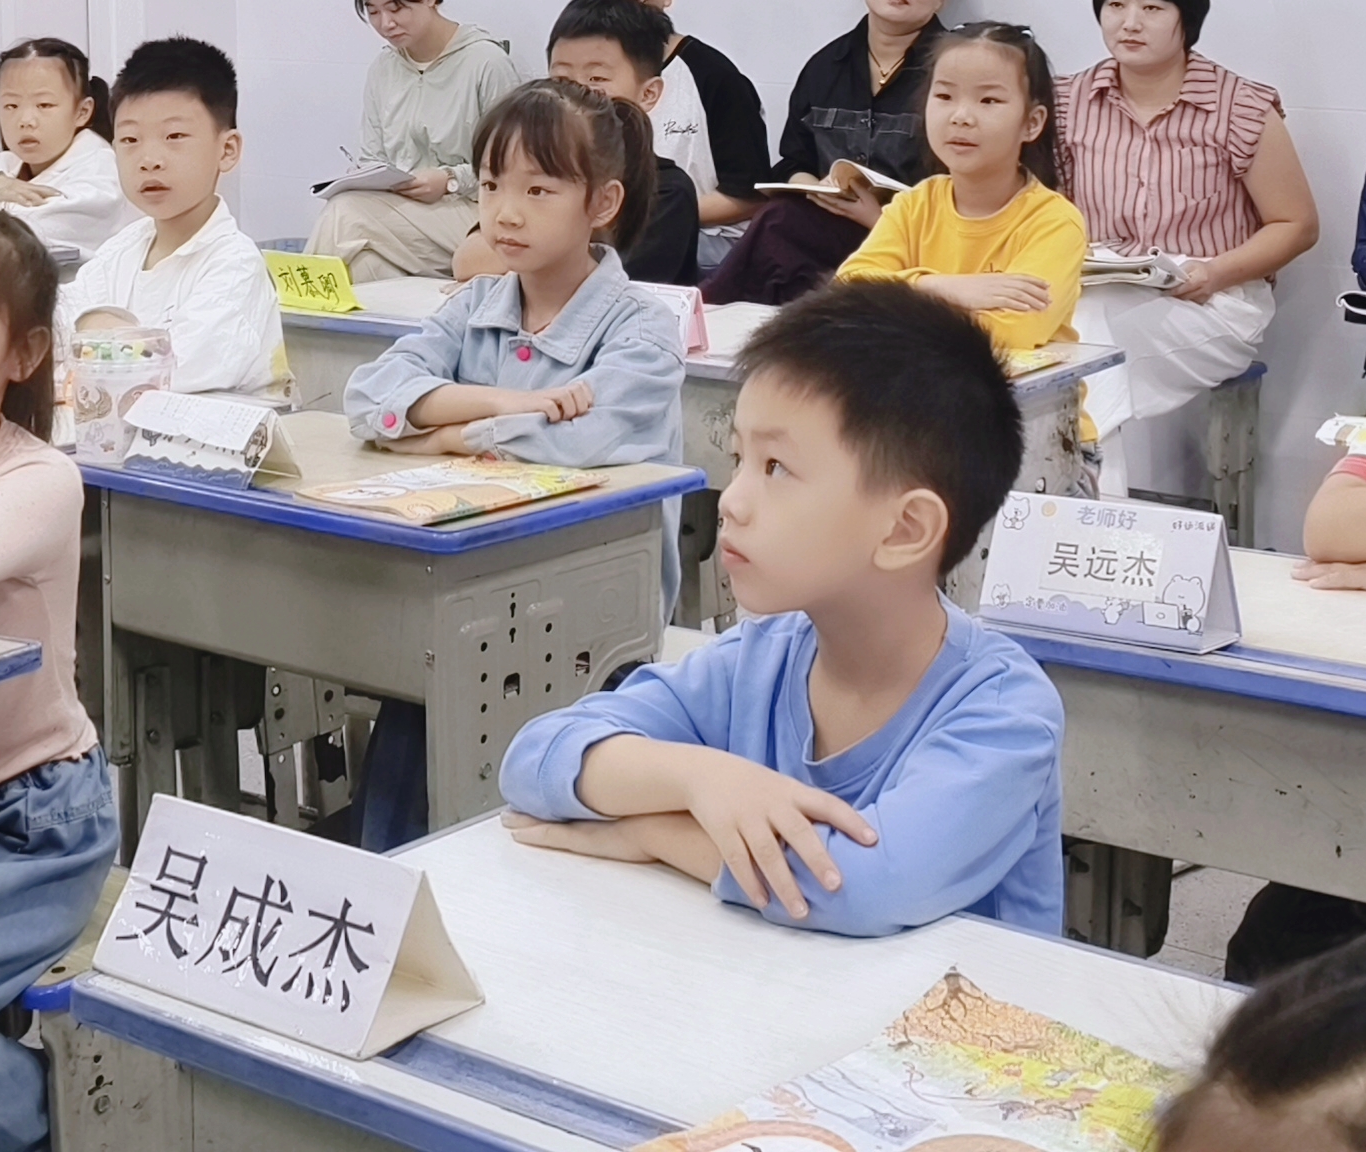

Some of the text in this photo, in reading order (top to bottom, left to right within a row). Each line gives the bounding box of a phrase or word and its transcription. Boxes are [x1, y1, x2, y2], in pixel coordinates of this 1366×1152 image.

[1076, 506, 1138, 532] 老师好
[1047, 541, 1158, 588] 吴远杰
[115, 845, 375, 1013] 吴成杰
